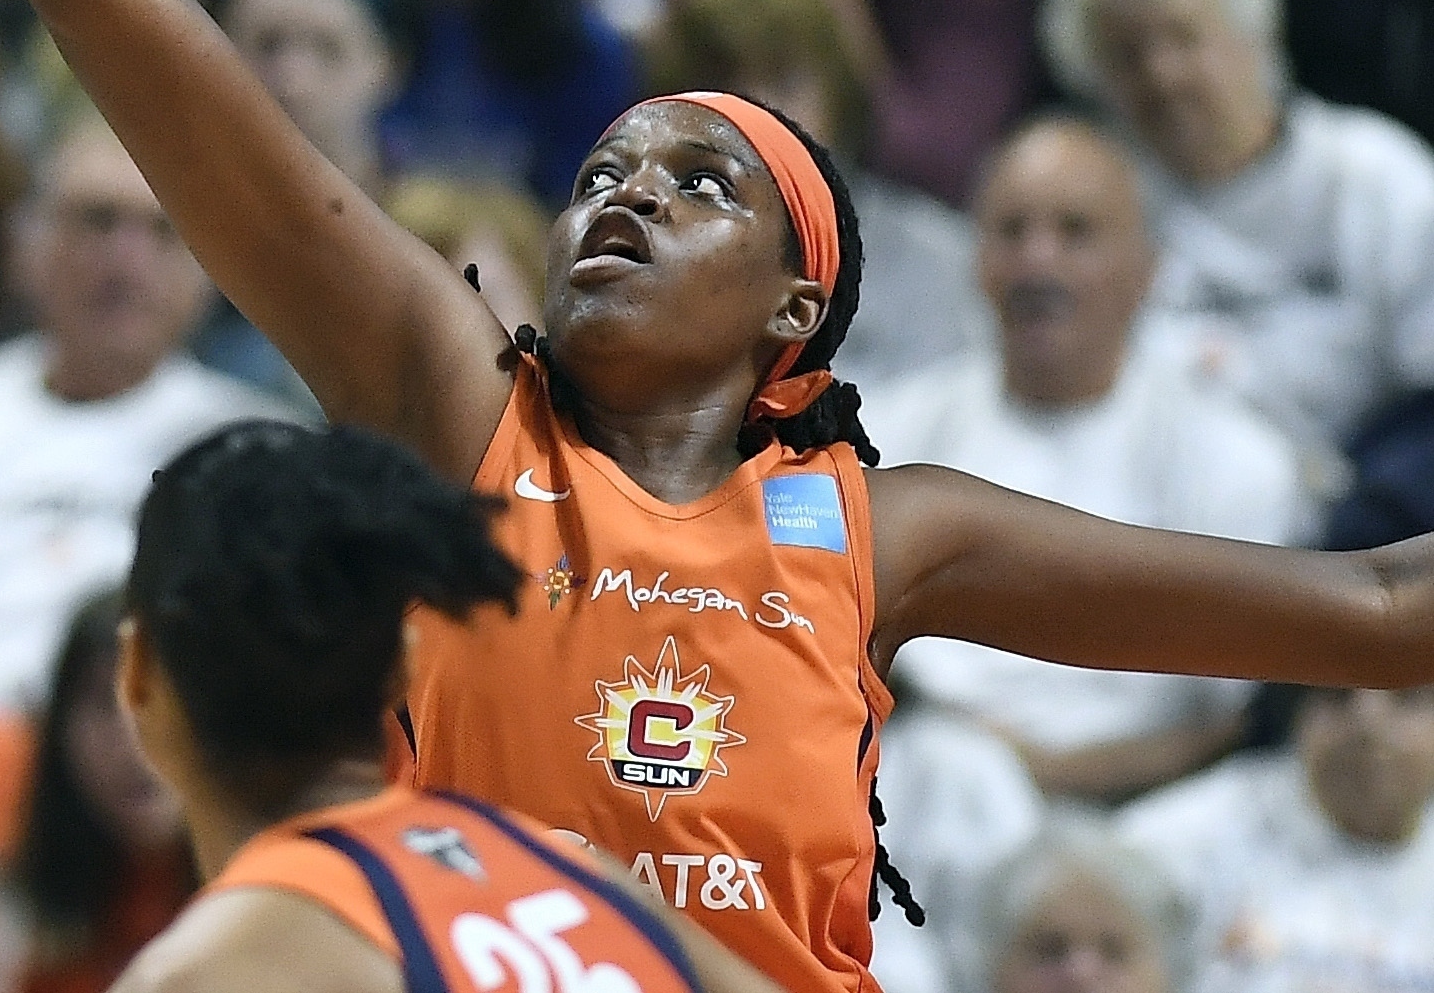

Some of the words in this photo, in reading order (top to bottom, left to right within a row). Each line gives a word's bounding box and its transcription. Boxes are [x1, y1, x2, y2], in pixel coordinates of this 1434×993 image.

[765, 493, 793, 504] Yale
[772, 515, 818, 529] Health
[590, 567, 748, 621] Mohegan
[755, 590, 815, 634] Sun
[626, 698, 695, 762] C
[622, 763, 690, 786] SUN
[629, 851, 766, 911] AT&T
